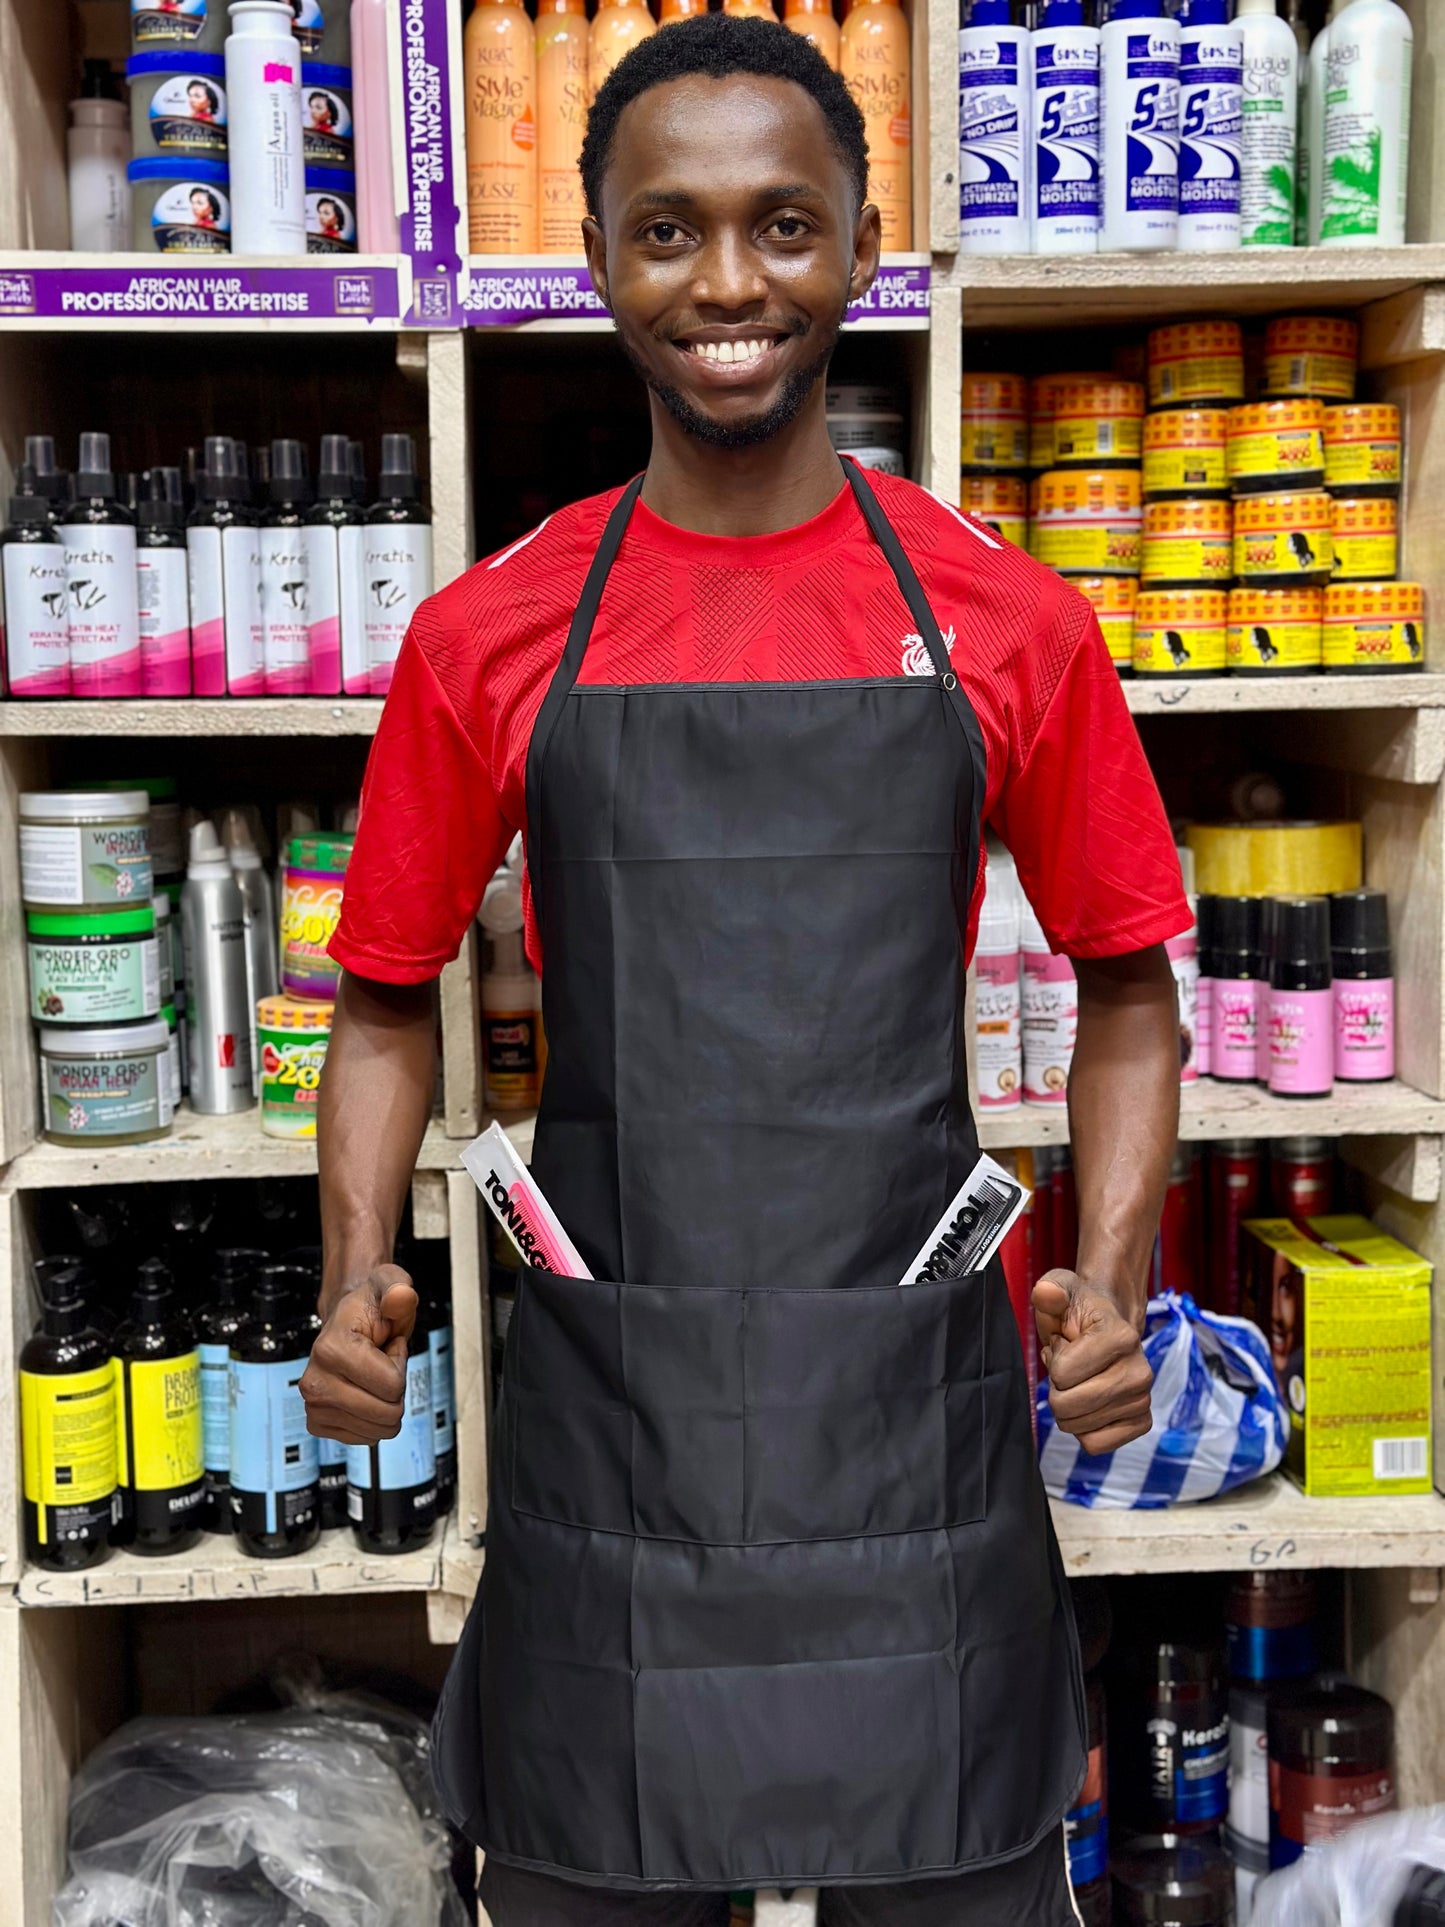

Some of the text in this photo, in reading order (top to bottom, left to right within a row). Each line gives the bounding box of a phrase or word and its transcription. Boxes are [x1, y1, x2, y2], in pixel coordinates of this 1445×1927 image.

[475, 75, 523, 102] Style
[851, 73, 901, 99] Style
[271, 93, 280, 108] oil
[473, 98, 522, 120] Magic
[269, 111, 282, 151] Argan
[425, 64, 444, 183] AFRICAN HAIR
[963, 182, 1015, 194] ACTIVATOR
[412, 152, 433, 252] EXPERTISE
[128, 278, 241, 294] AFRICAN HAIR
[338, 280, 369, 293] Dark
[470, 276, 578, 293] AFRICAN HAIR
[870, 275, 908, 291] HAIR
[61, 292, 309, 312] PROFESSIONAL EXPERTISE
[338, 292, 371, 307] Lovely
[35, 948, 131, 961] WONDER GRO
[45, 959, 119, 975] JAMAICAN
[51, 1062, 149, 1078] WONDER GRO
[59, 1072, 142, 1089] INDIAN HEMP
[981, 1223, 1001, 1251] TONI&GUY
